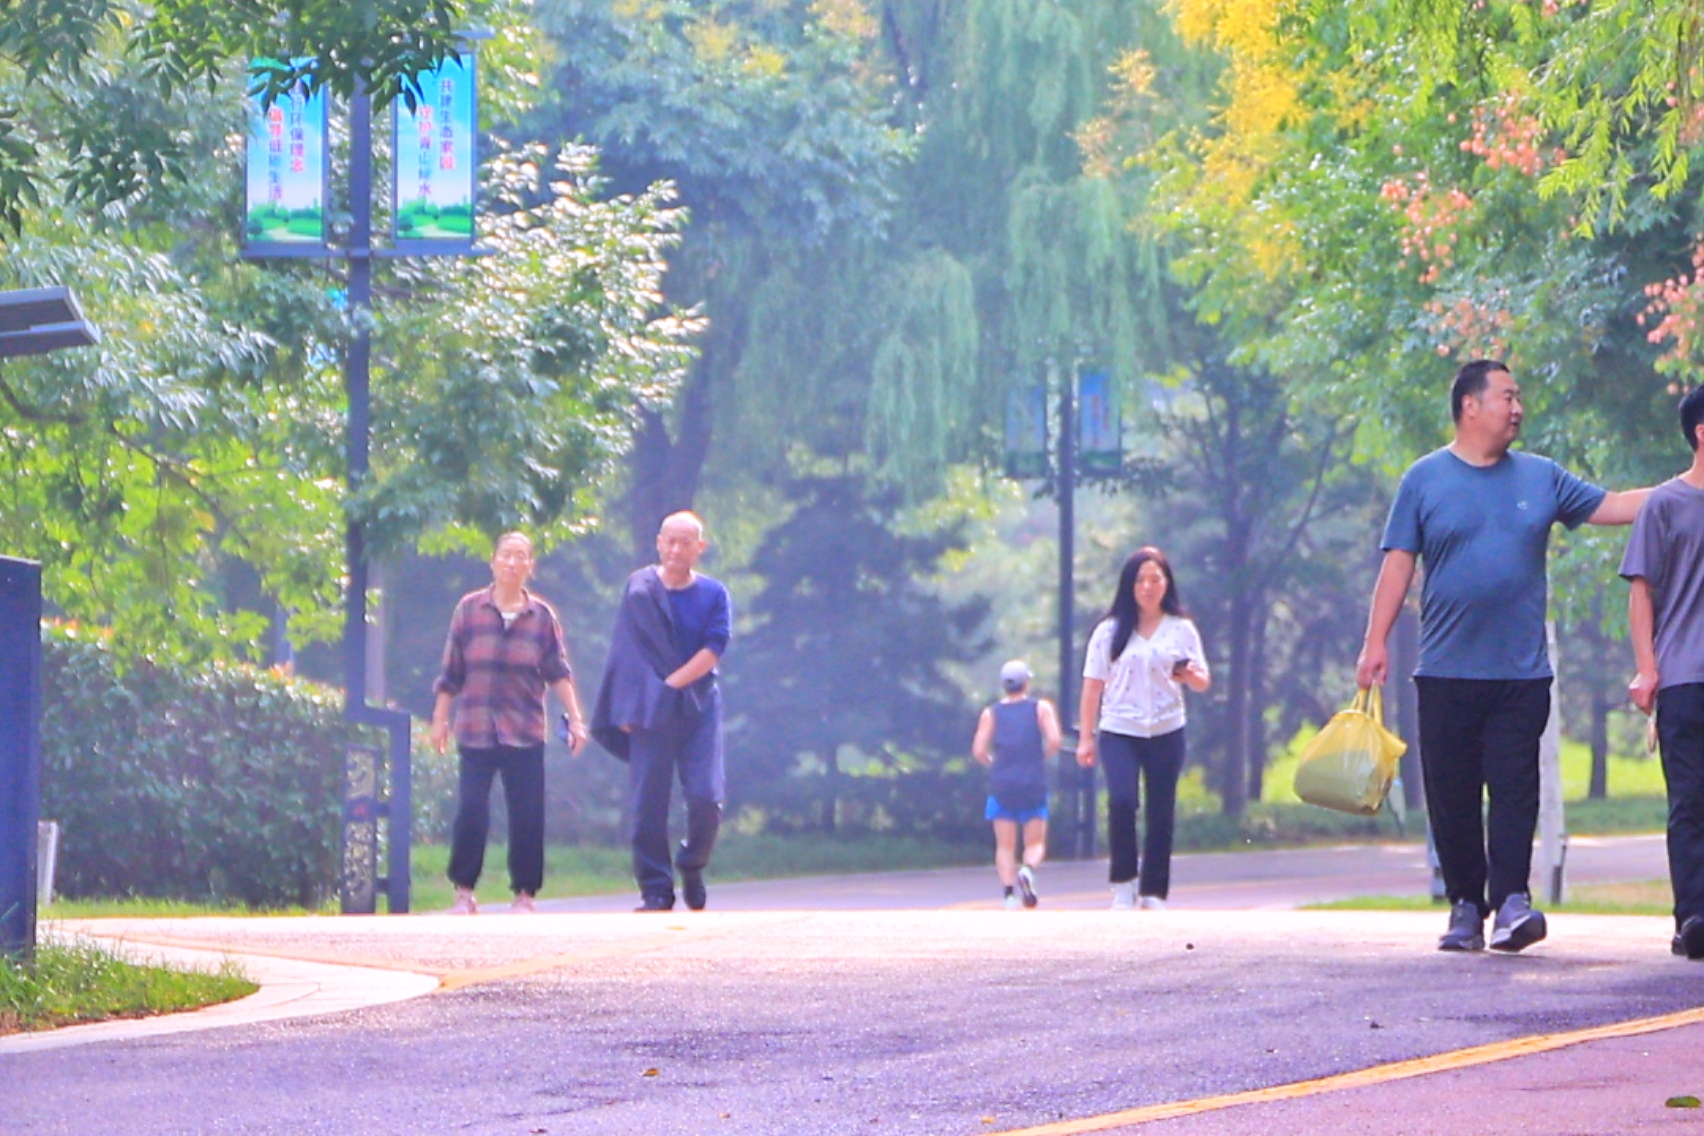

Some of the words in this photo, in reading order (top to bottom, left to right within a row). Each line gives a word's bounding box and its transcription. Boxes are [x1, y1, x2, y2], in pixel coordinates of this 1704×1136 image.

[440, 78, 454, 169] 共建生态家园
